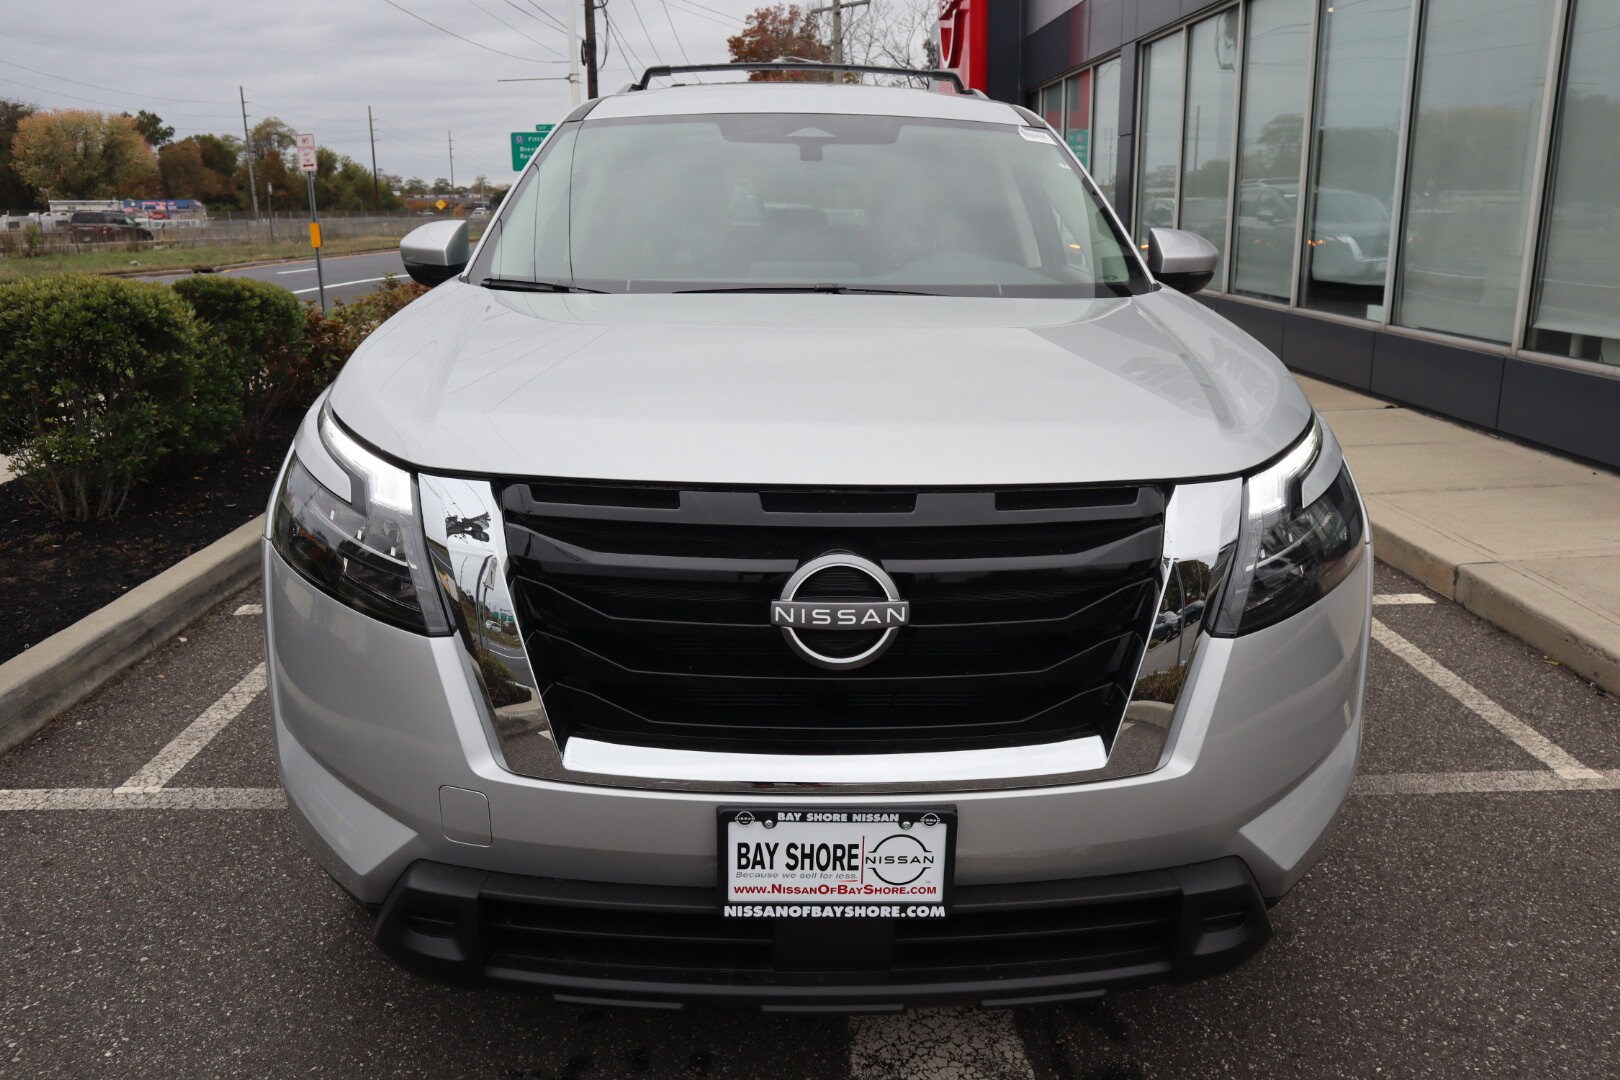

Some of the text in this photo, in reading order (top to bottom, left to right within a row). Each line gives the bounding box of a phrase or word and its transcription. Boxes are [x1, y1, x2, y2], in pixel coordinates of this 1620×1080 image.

[775, 606, 905, 625] NISSAN
[777, 812, 900, 822] BAY SHORE NISSAN
[736, 842, 860, 872] BAY SHORE
[865, 855, 935, 865] NISSAN
[735, 871, 779, 879] Because
[819, 872, 832, 880] for
[835, 872, 858, 880] less.
[723, 905, 946, 918] NISSANOFBAYSHORE.COM
